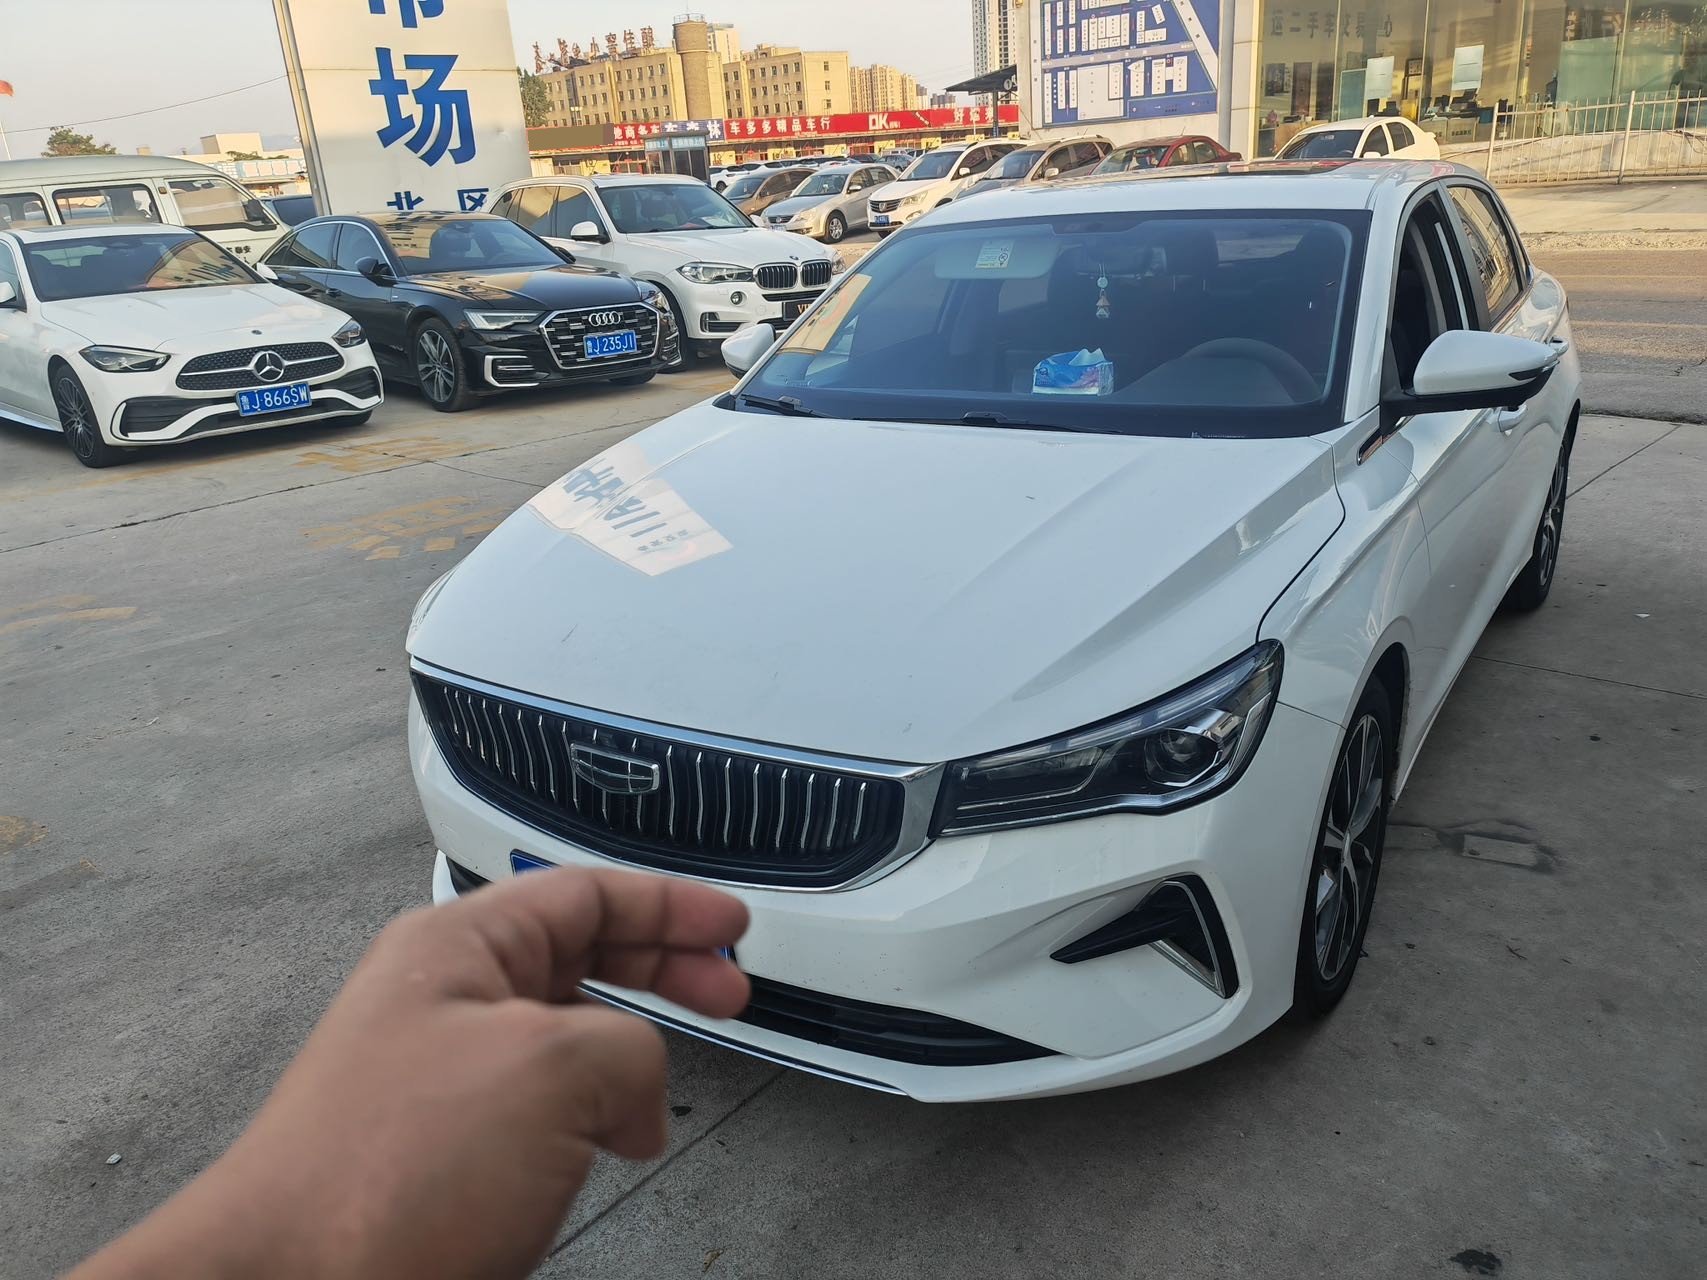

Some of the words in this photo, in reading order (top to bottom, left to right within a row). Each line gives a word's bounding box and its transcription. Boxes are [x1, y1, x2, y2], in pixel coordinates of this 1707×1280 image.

[368, 0, 476, 167] 场
[729, 117, 831, 136] 车多多精品车行
[868, 113, 889, 130] OK
